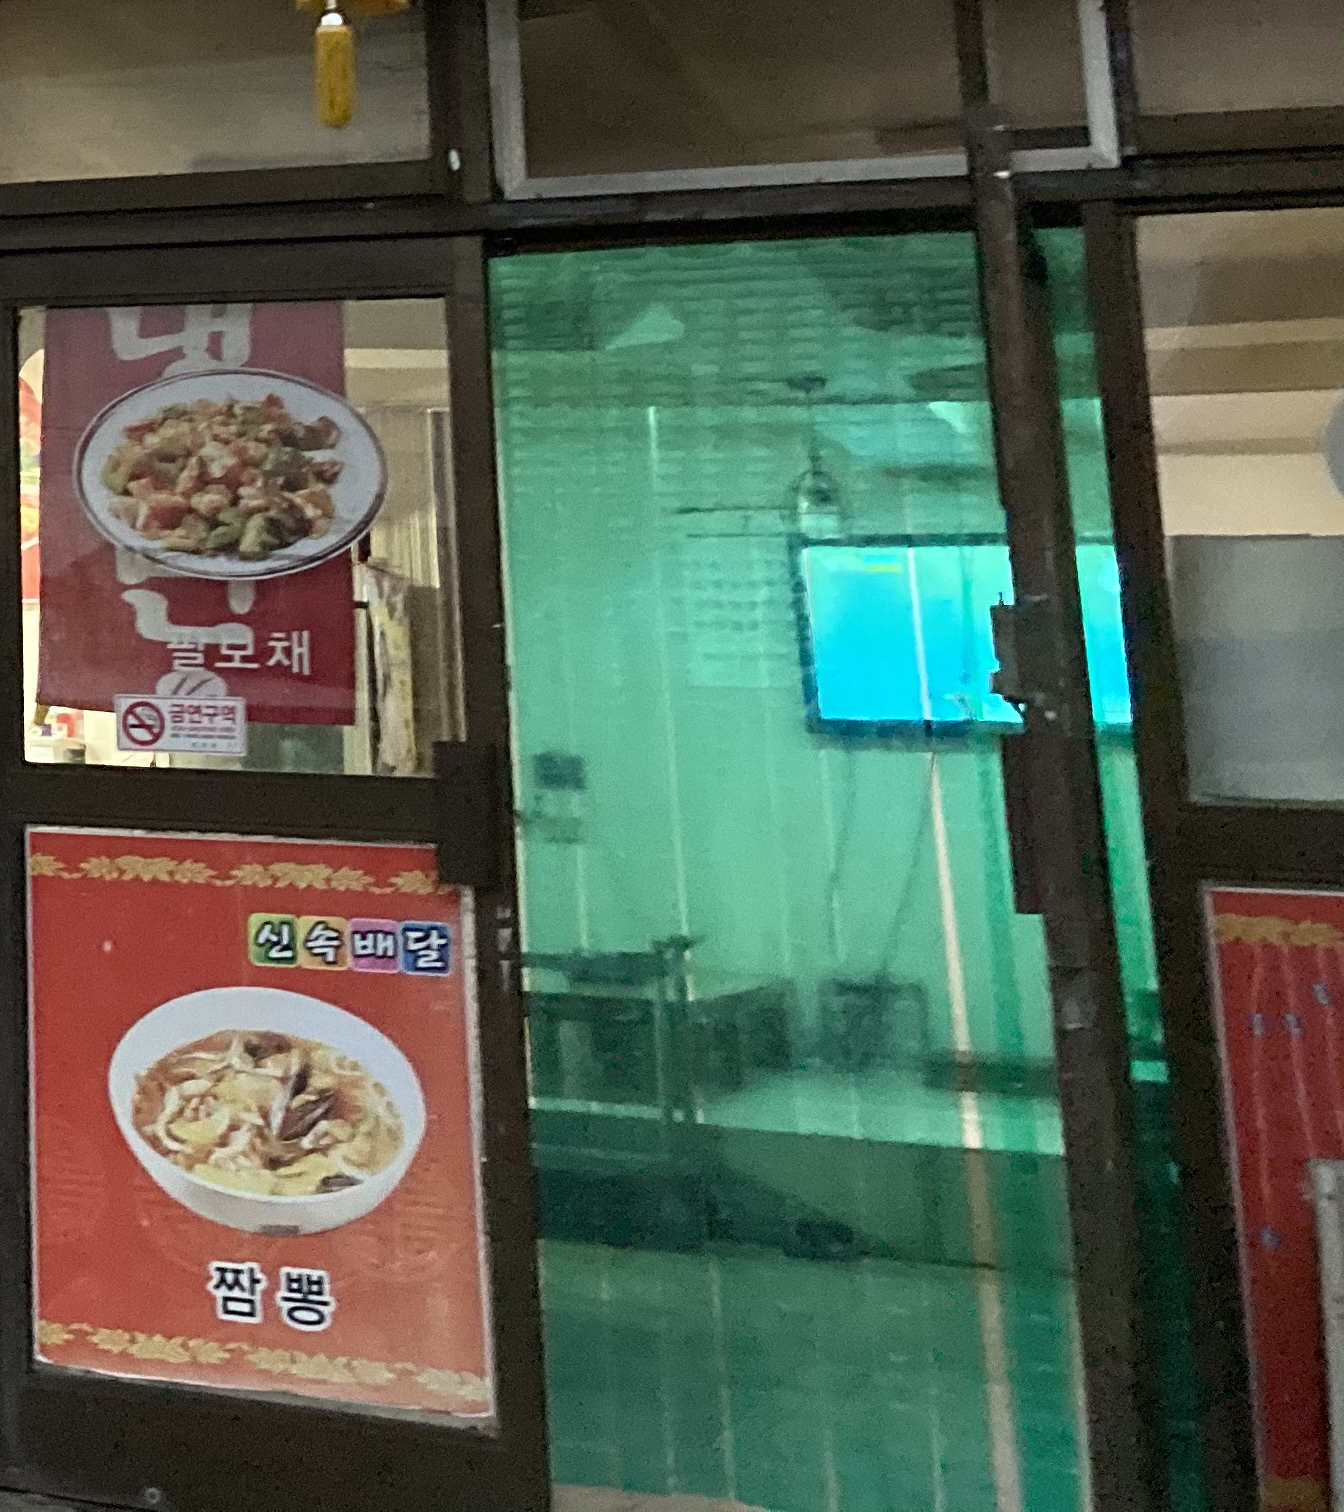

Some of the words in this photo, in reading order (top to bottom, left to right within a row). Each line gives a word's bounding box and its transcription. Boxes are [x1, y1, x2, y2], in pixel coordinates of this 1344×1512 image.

[169, 702, 237, 726] 금연구역
[254, 918, 450, 970] 신속배달
[207, 1260, 337, 1332] 짬뽕
